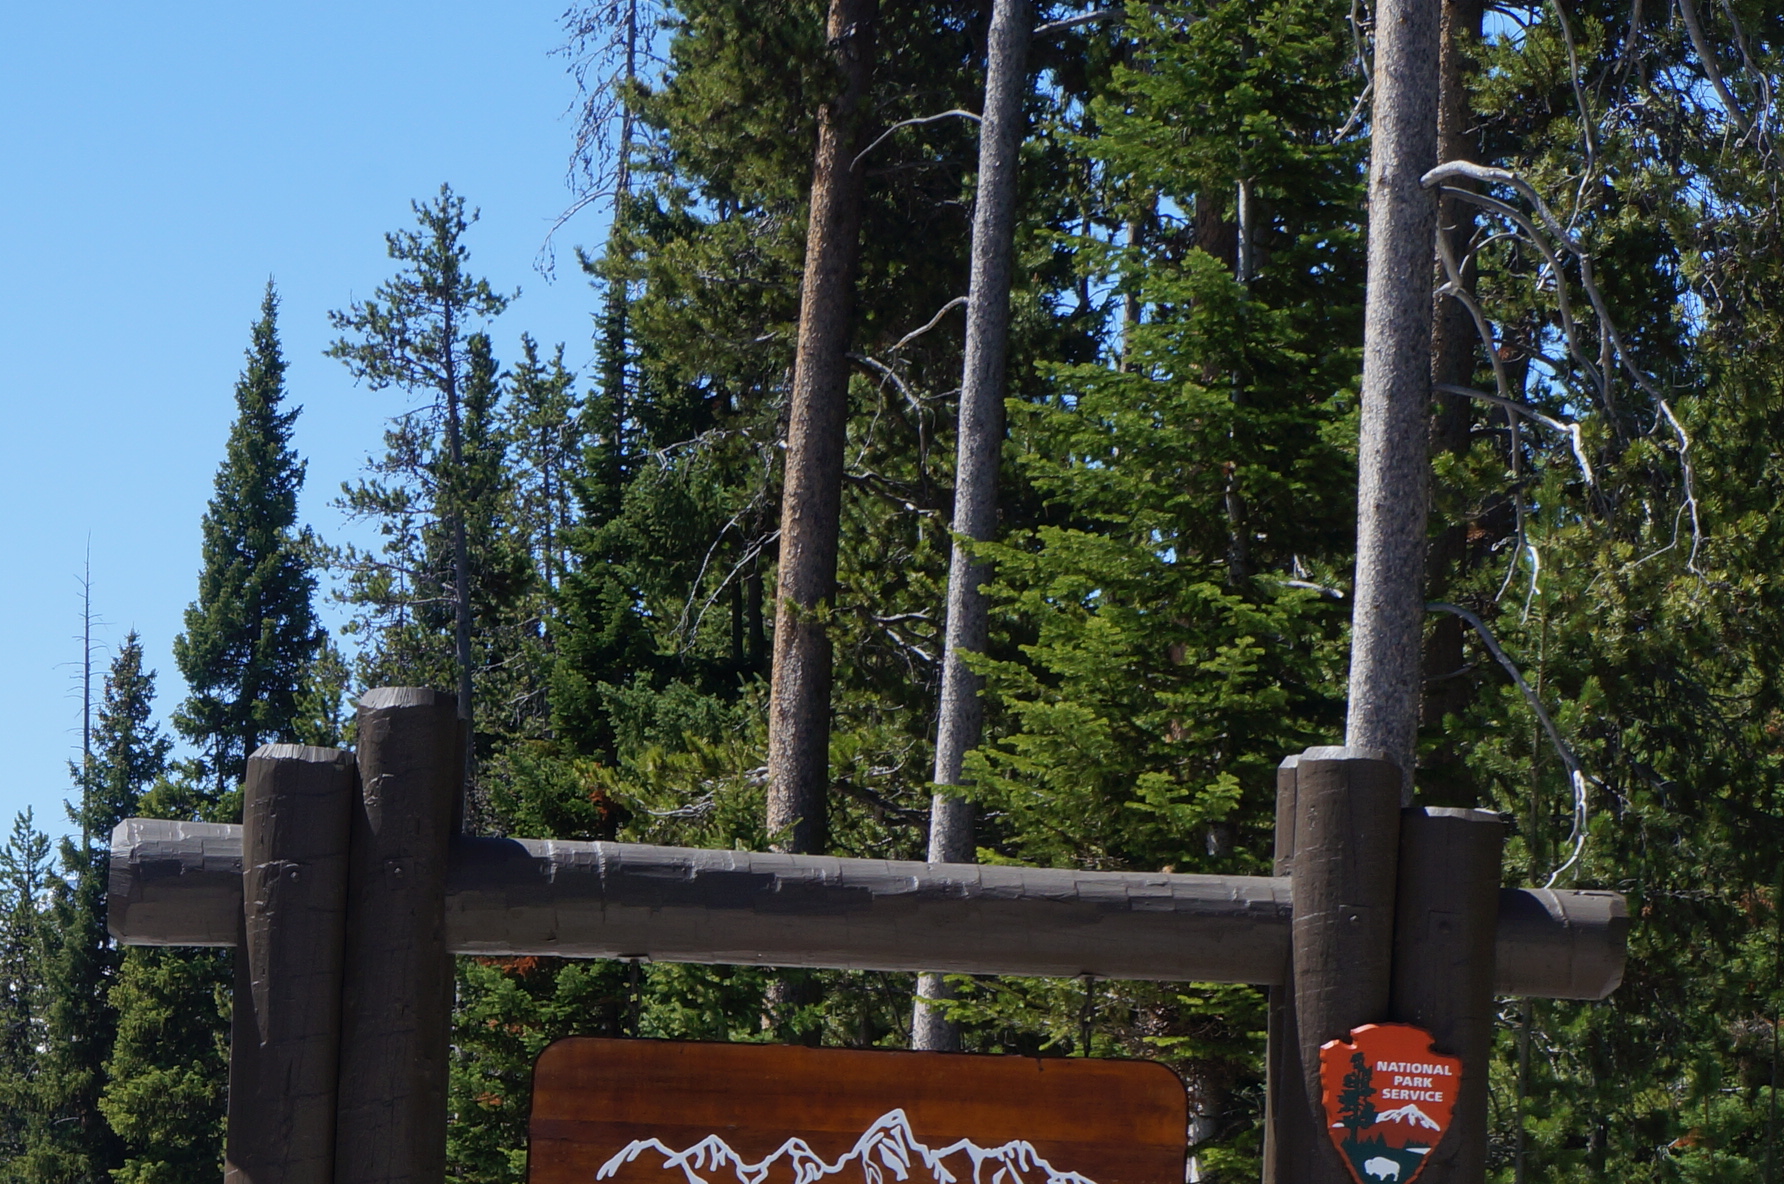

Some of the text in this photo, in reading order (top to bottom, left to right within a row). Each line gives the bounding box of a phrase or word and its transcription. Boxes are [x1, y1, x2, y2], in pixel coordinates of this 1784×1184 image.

[1376, 1060, 1453, 1076] NATIONAL
[1393, 1075, 1433, 1088] PARK
[1381, 1088, 1444, 1102] SERVICE
